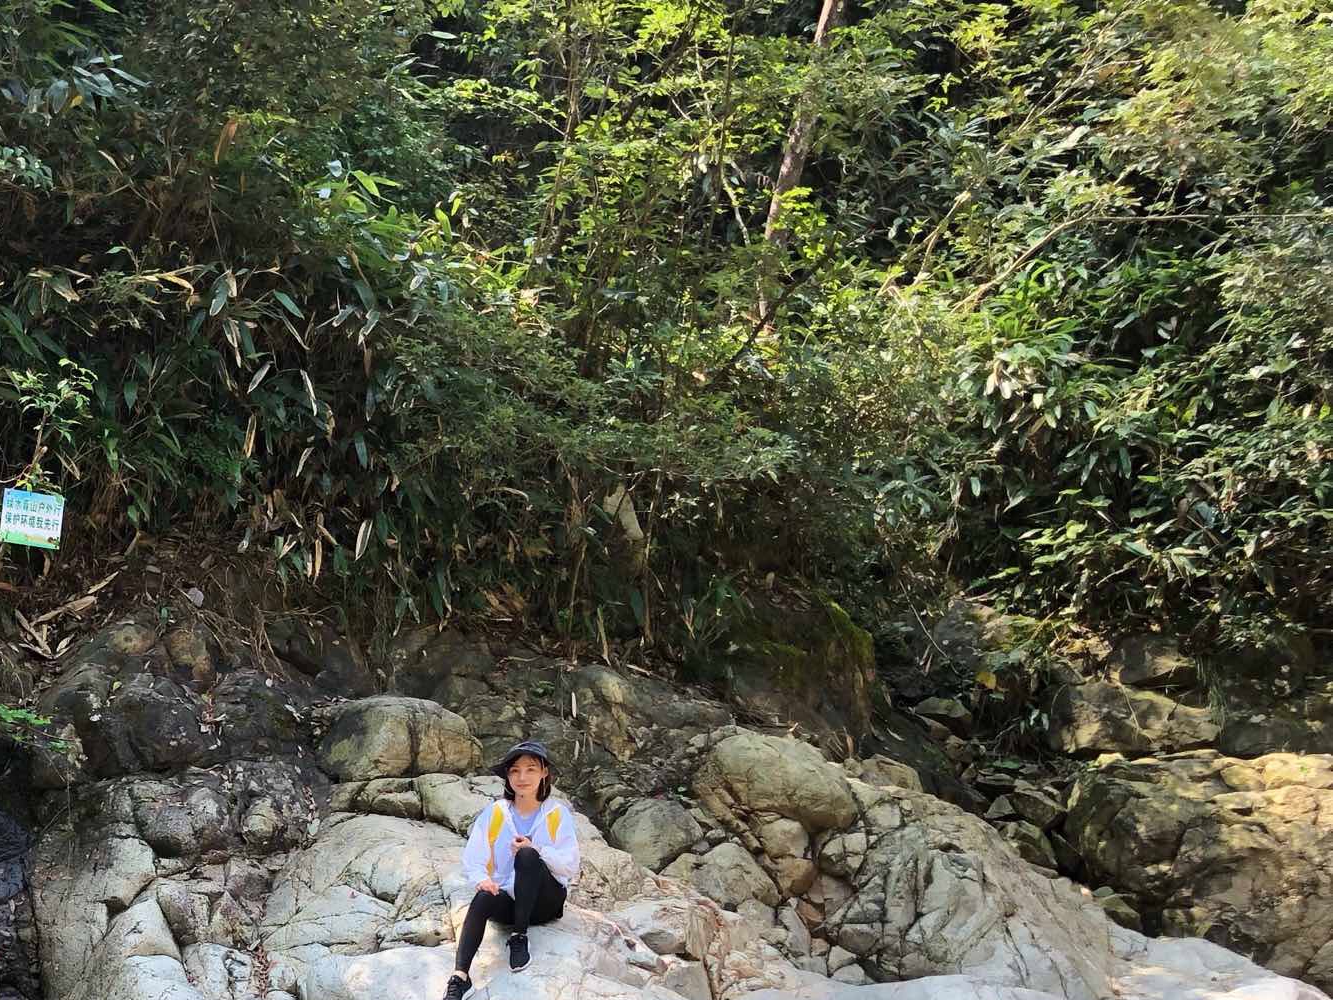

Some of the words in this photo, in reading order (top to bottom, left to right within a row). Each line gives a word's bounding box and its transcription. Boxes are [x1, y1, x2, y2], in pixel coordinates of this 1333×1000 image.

[5, 511, 59, 531] 保护环境我先行
